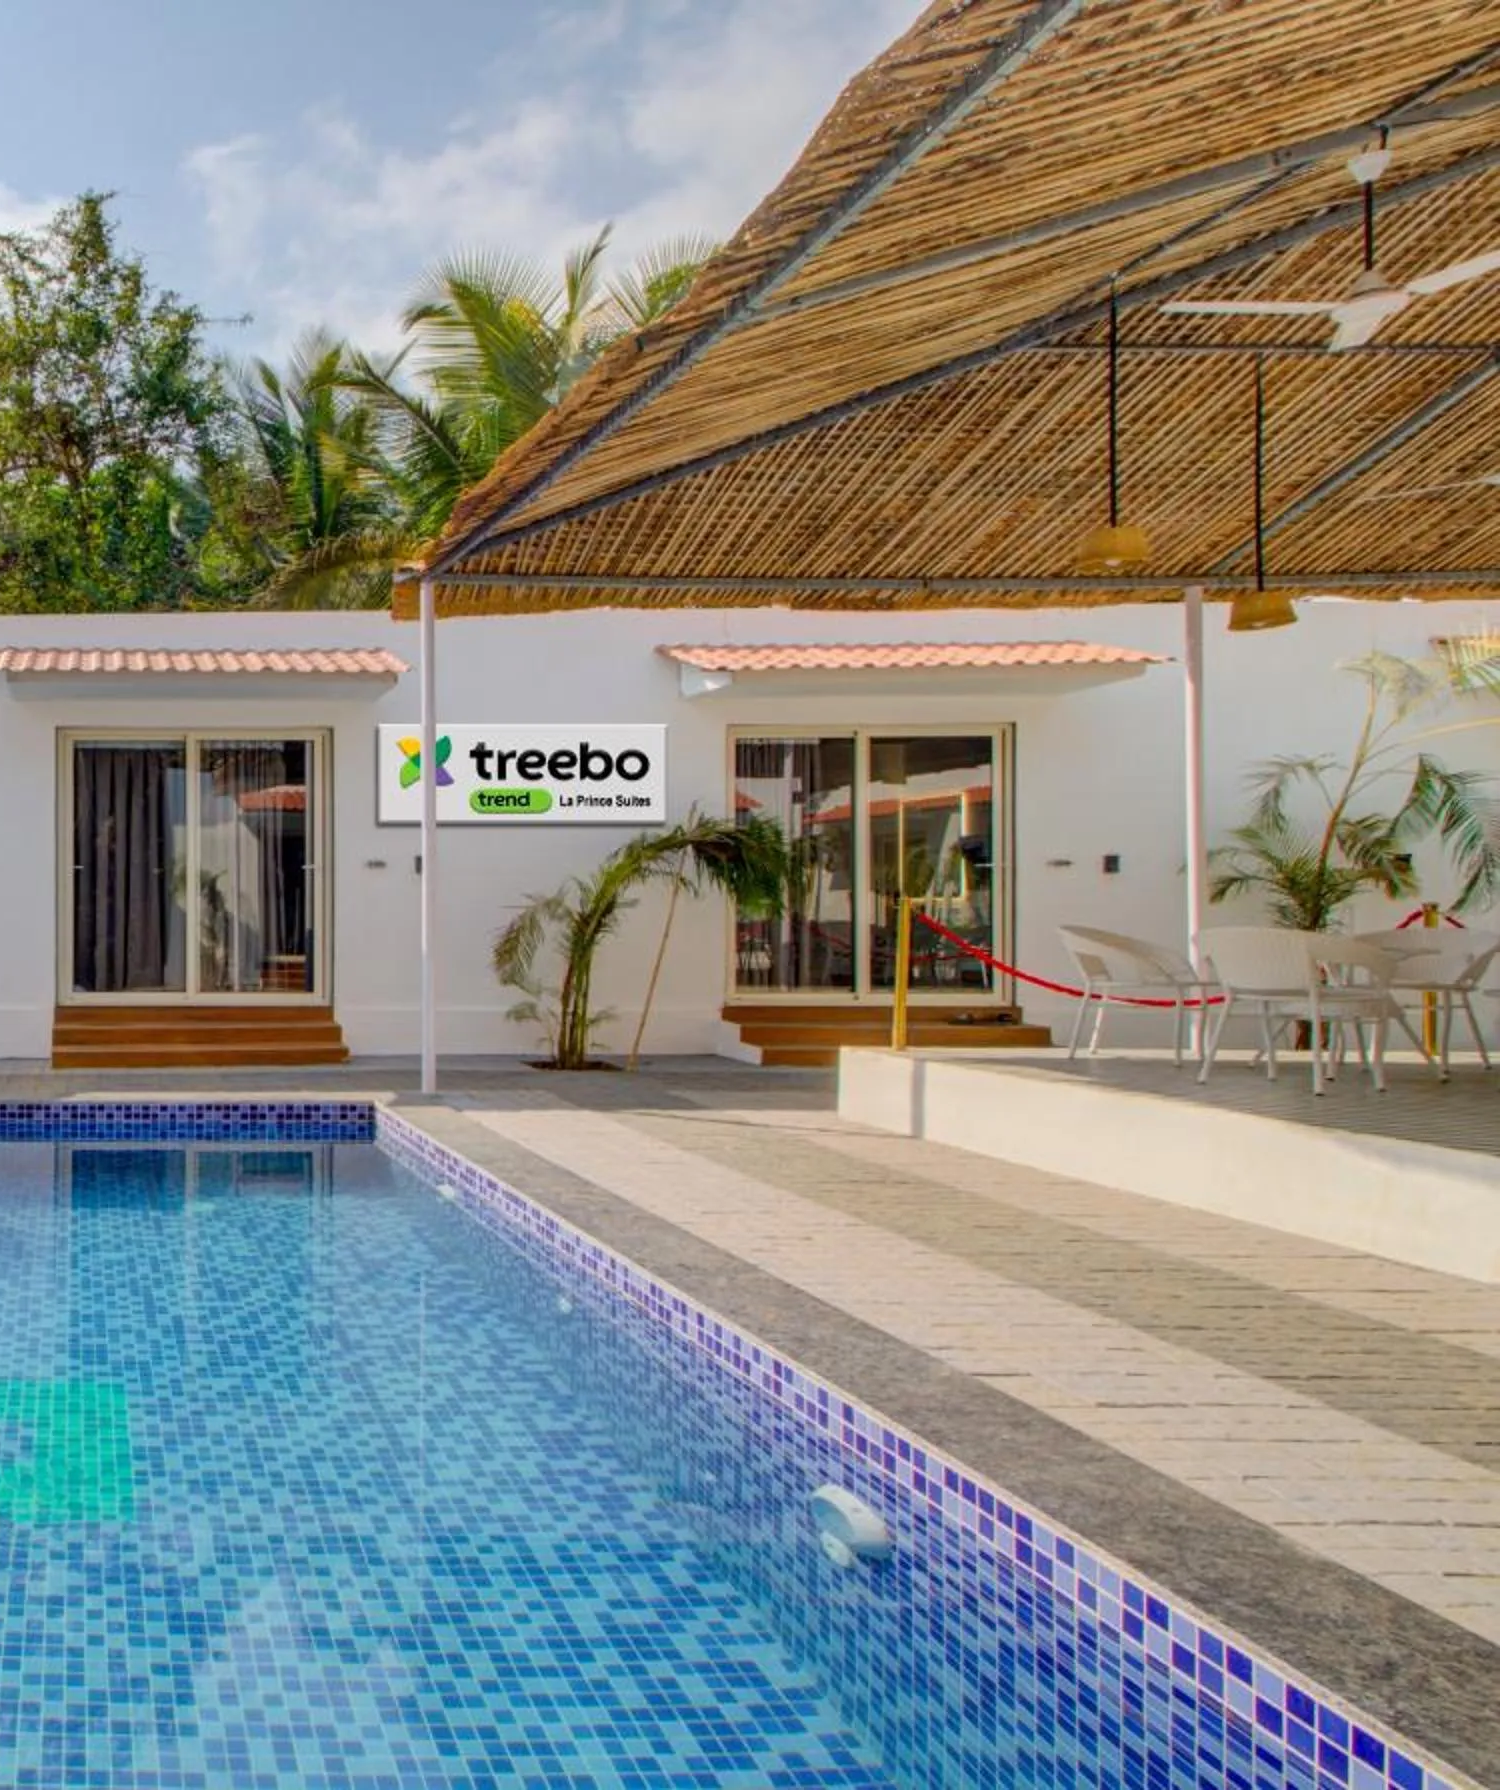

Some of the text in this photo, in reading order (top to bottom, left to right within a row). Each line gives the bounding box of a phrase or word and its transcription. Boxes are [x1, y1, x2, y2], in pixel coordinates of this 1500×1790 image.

[469, 741, 650, 781] treebo
[477, 791, 531, 807] trend
[559, 794, 651, 807] La Prince Suites
